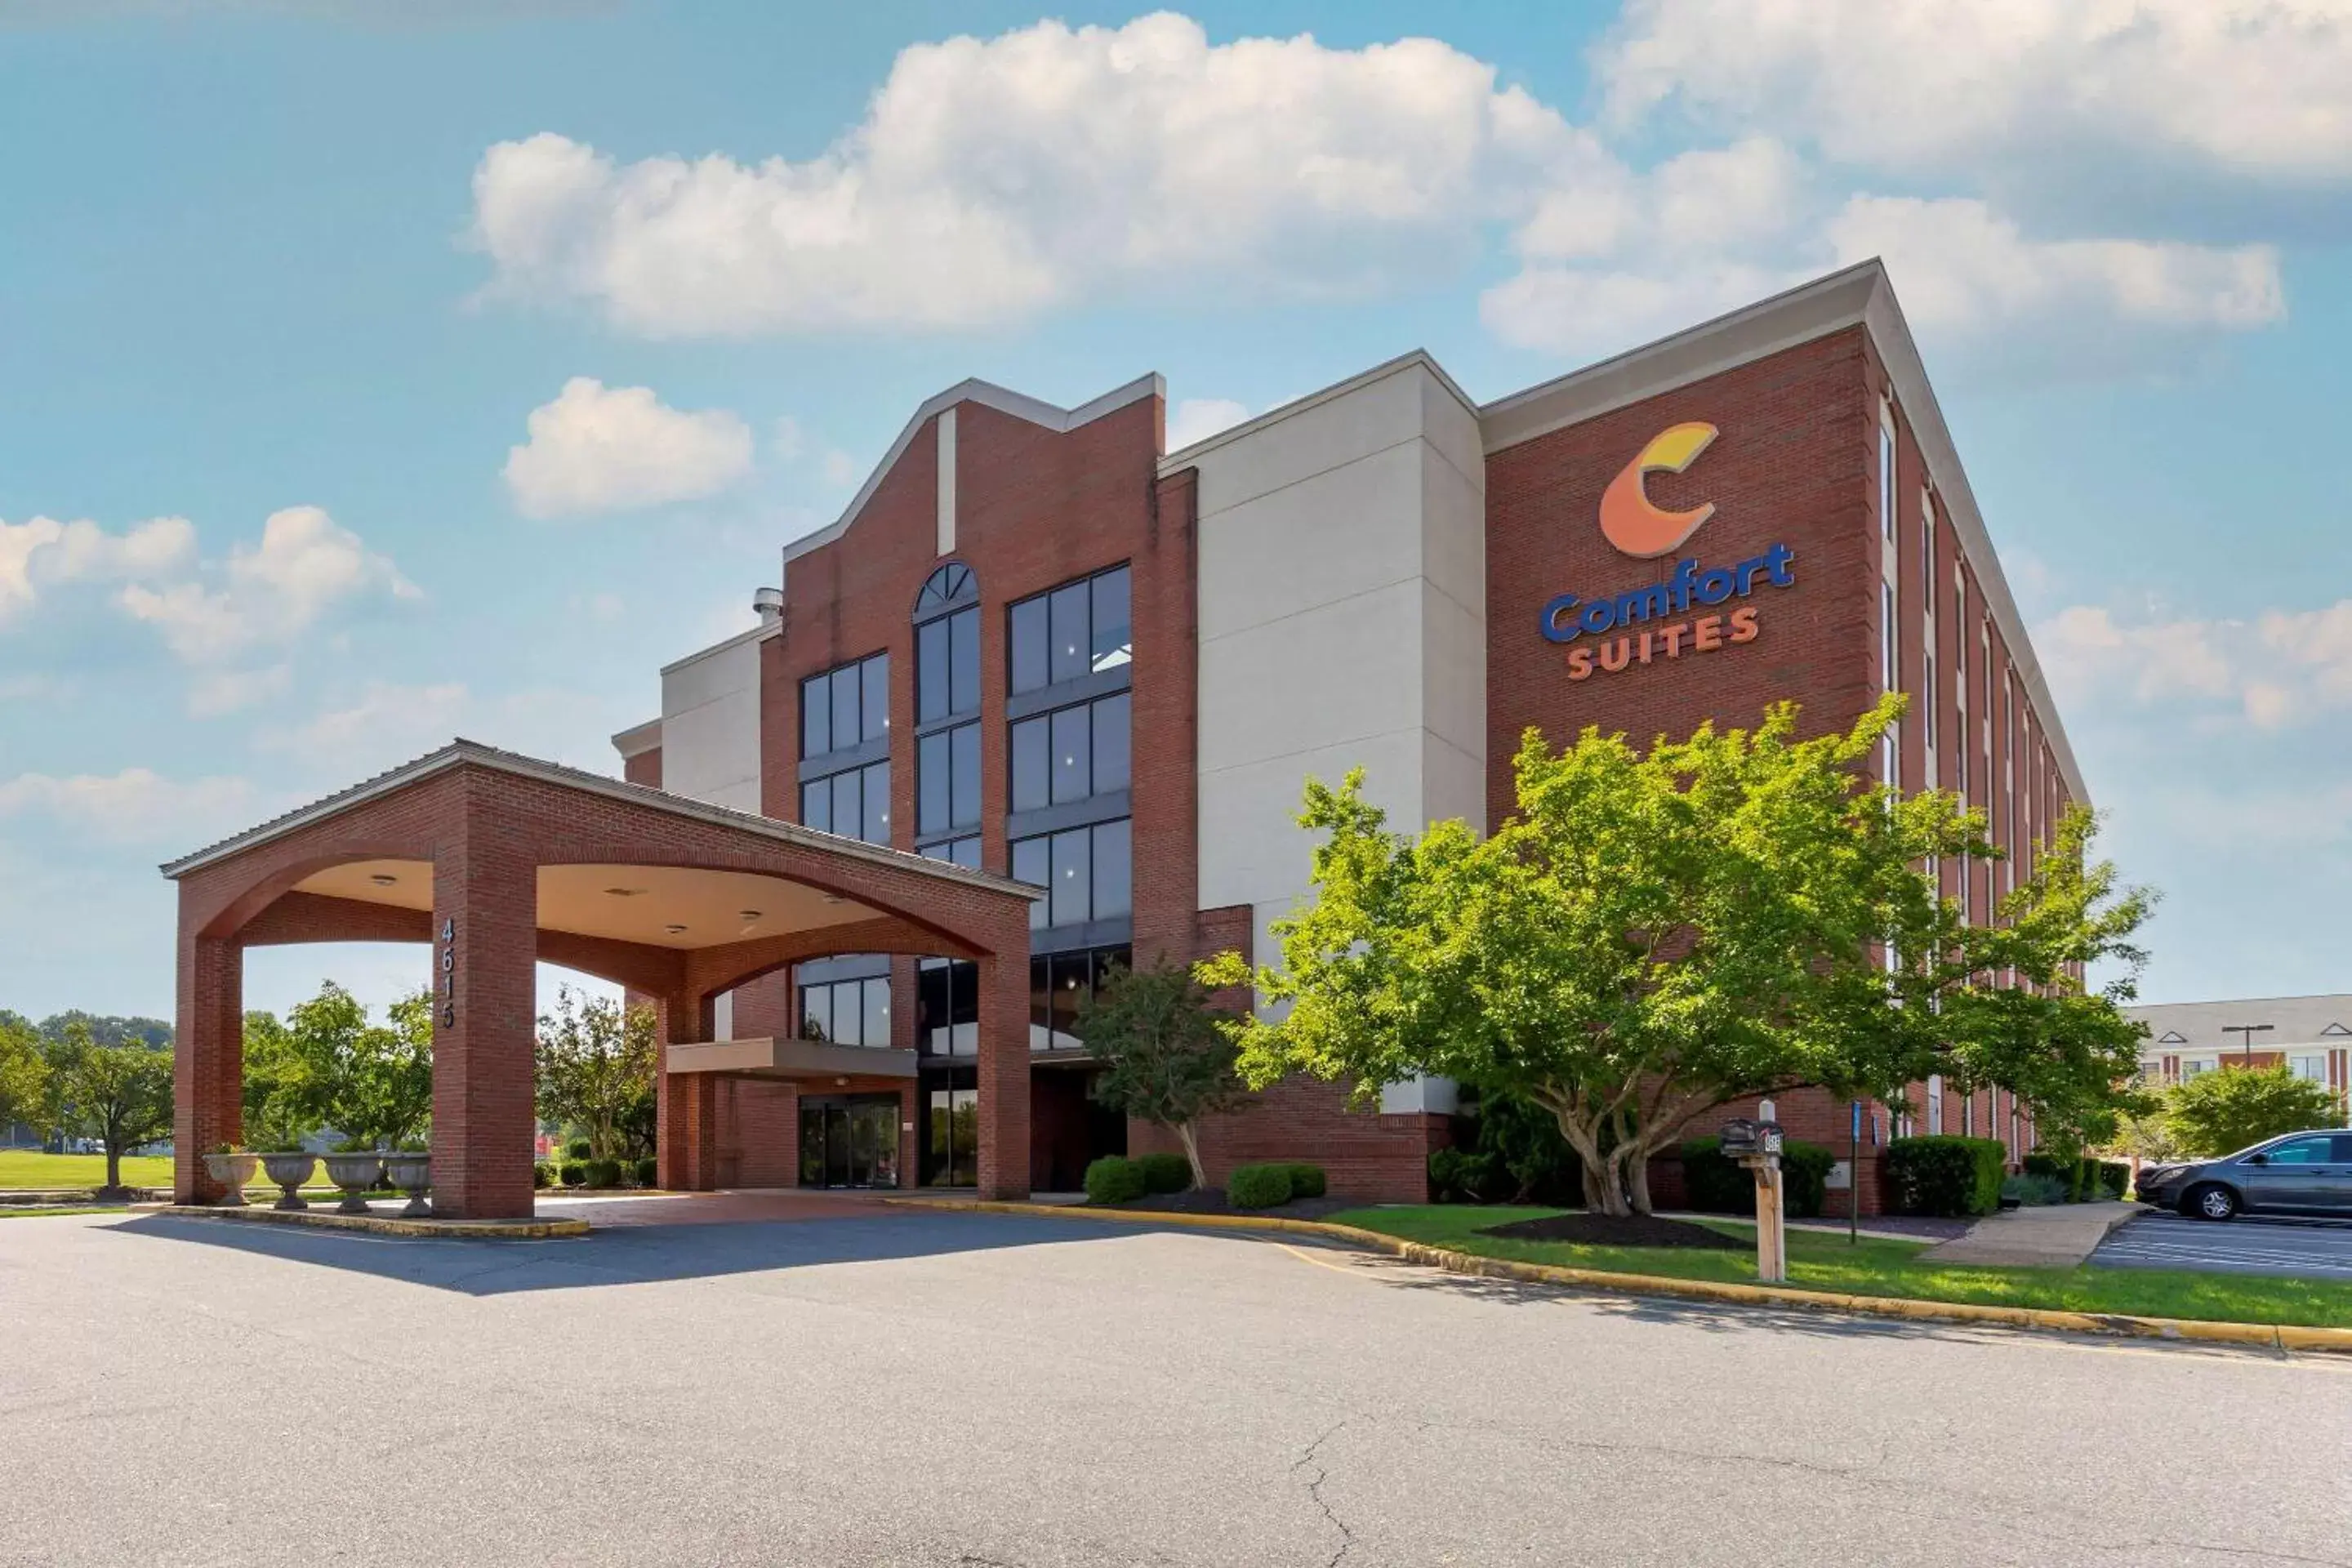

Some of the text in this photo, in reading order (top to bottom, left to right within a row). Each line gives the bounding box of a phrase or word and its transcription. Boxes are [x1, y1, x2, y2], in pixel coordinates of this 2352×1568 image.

[1539, 542, 1794, 642] Comfort
[1567, 606, 1758, 680] SUITES
[442, 917, 455, 1028] 4615
